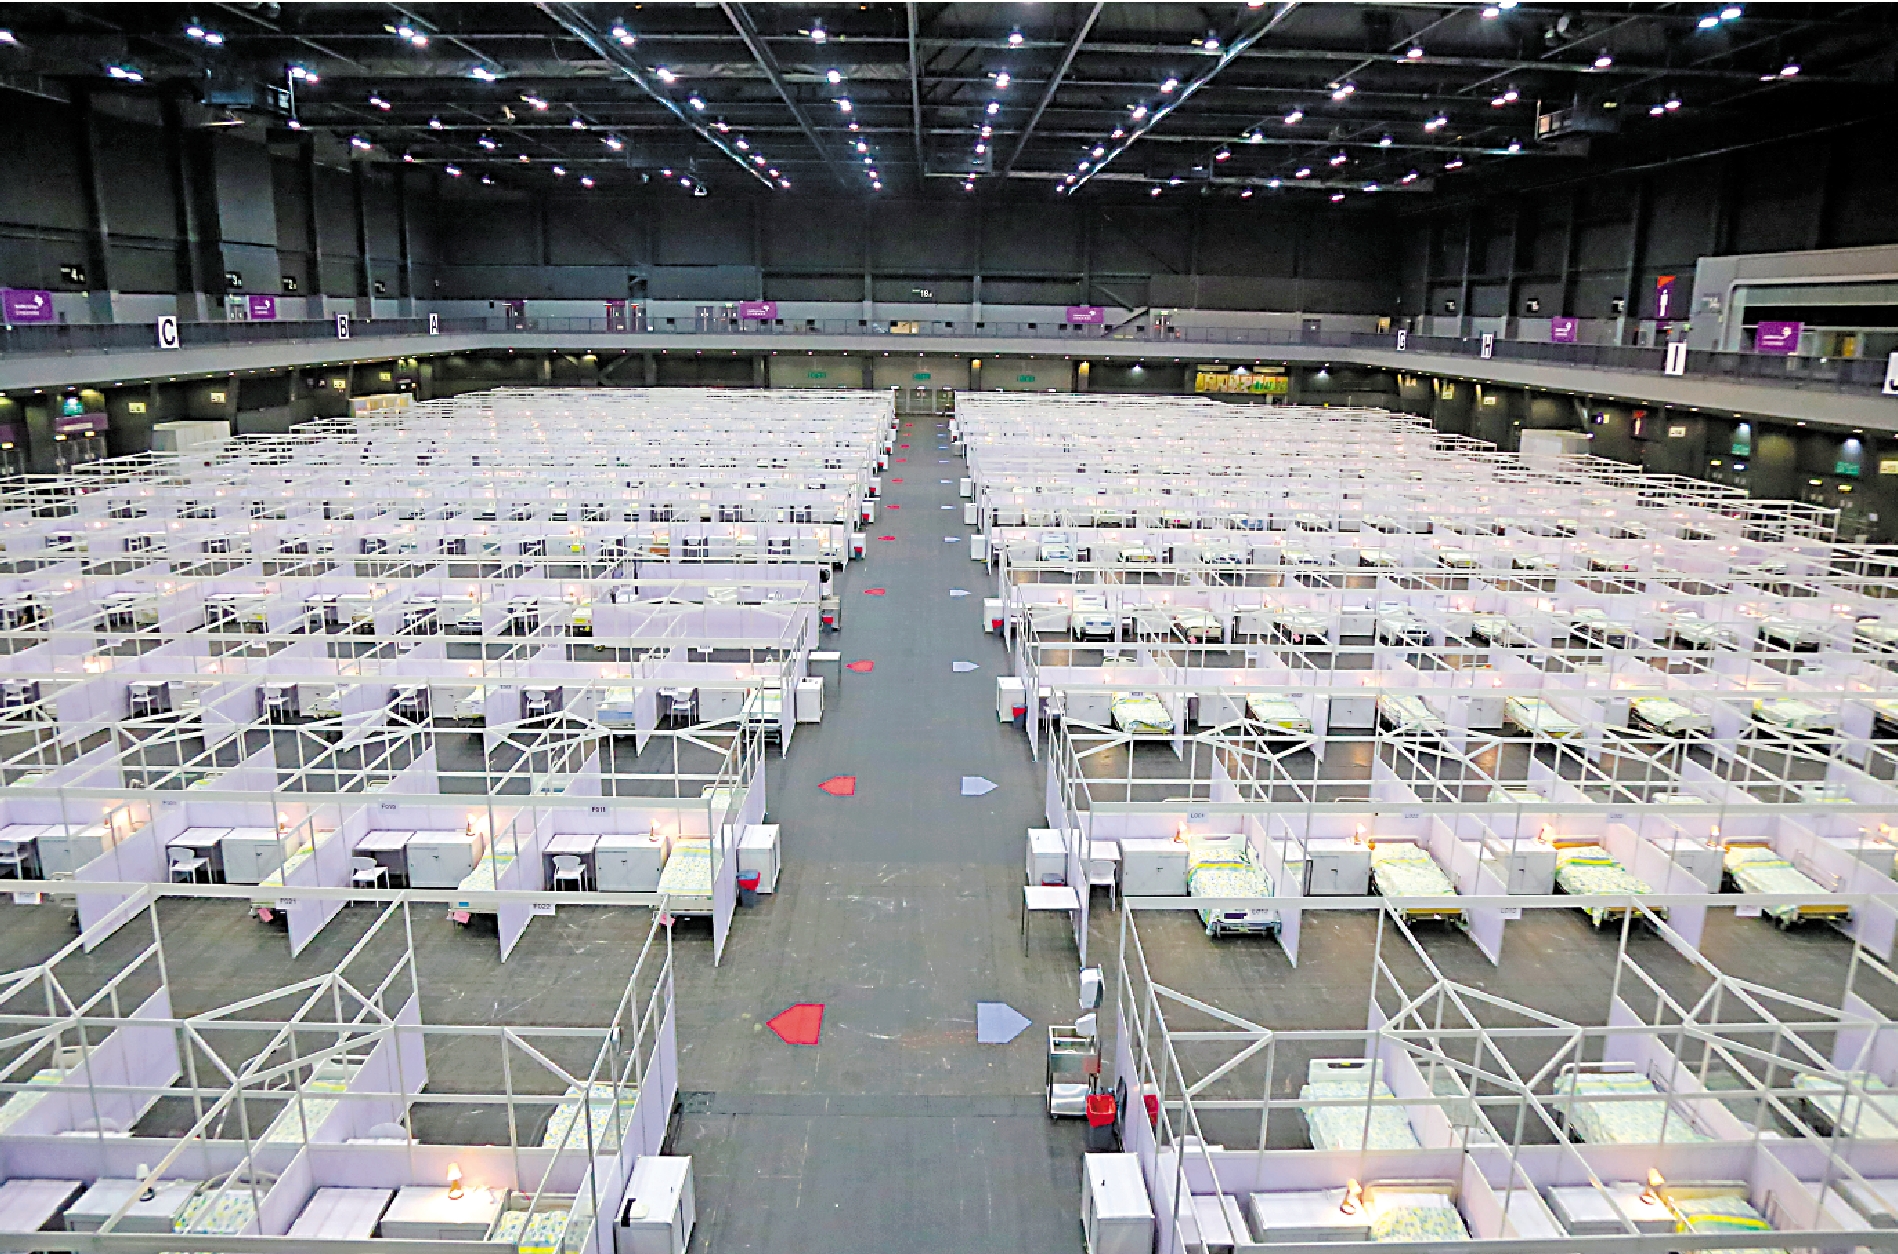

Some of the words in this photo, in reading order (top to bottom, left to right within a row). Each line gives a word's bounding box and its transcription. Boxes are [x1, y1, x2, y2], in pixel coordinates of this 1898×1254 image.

[163, 318, 176, 346] C
[339, 316, 348, 338] B
[431, 315, 437, 334] A
[1483, 336, 1492, 357] H
